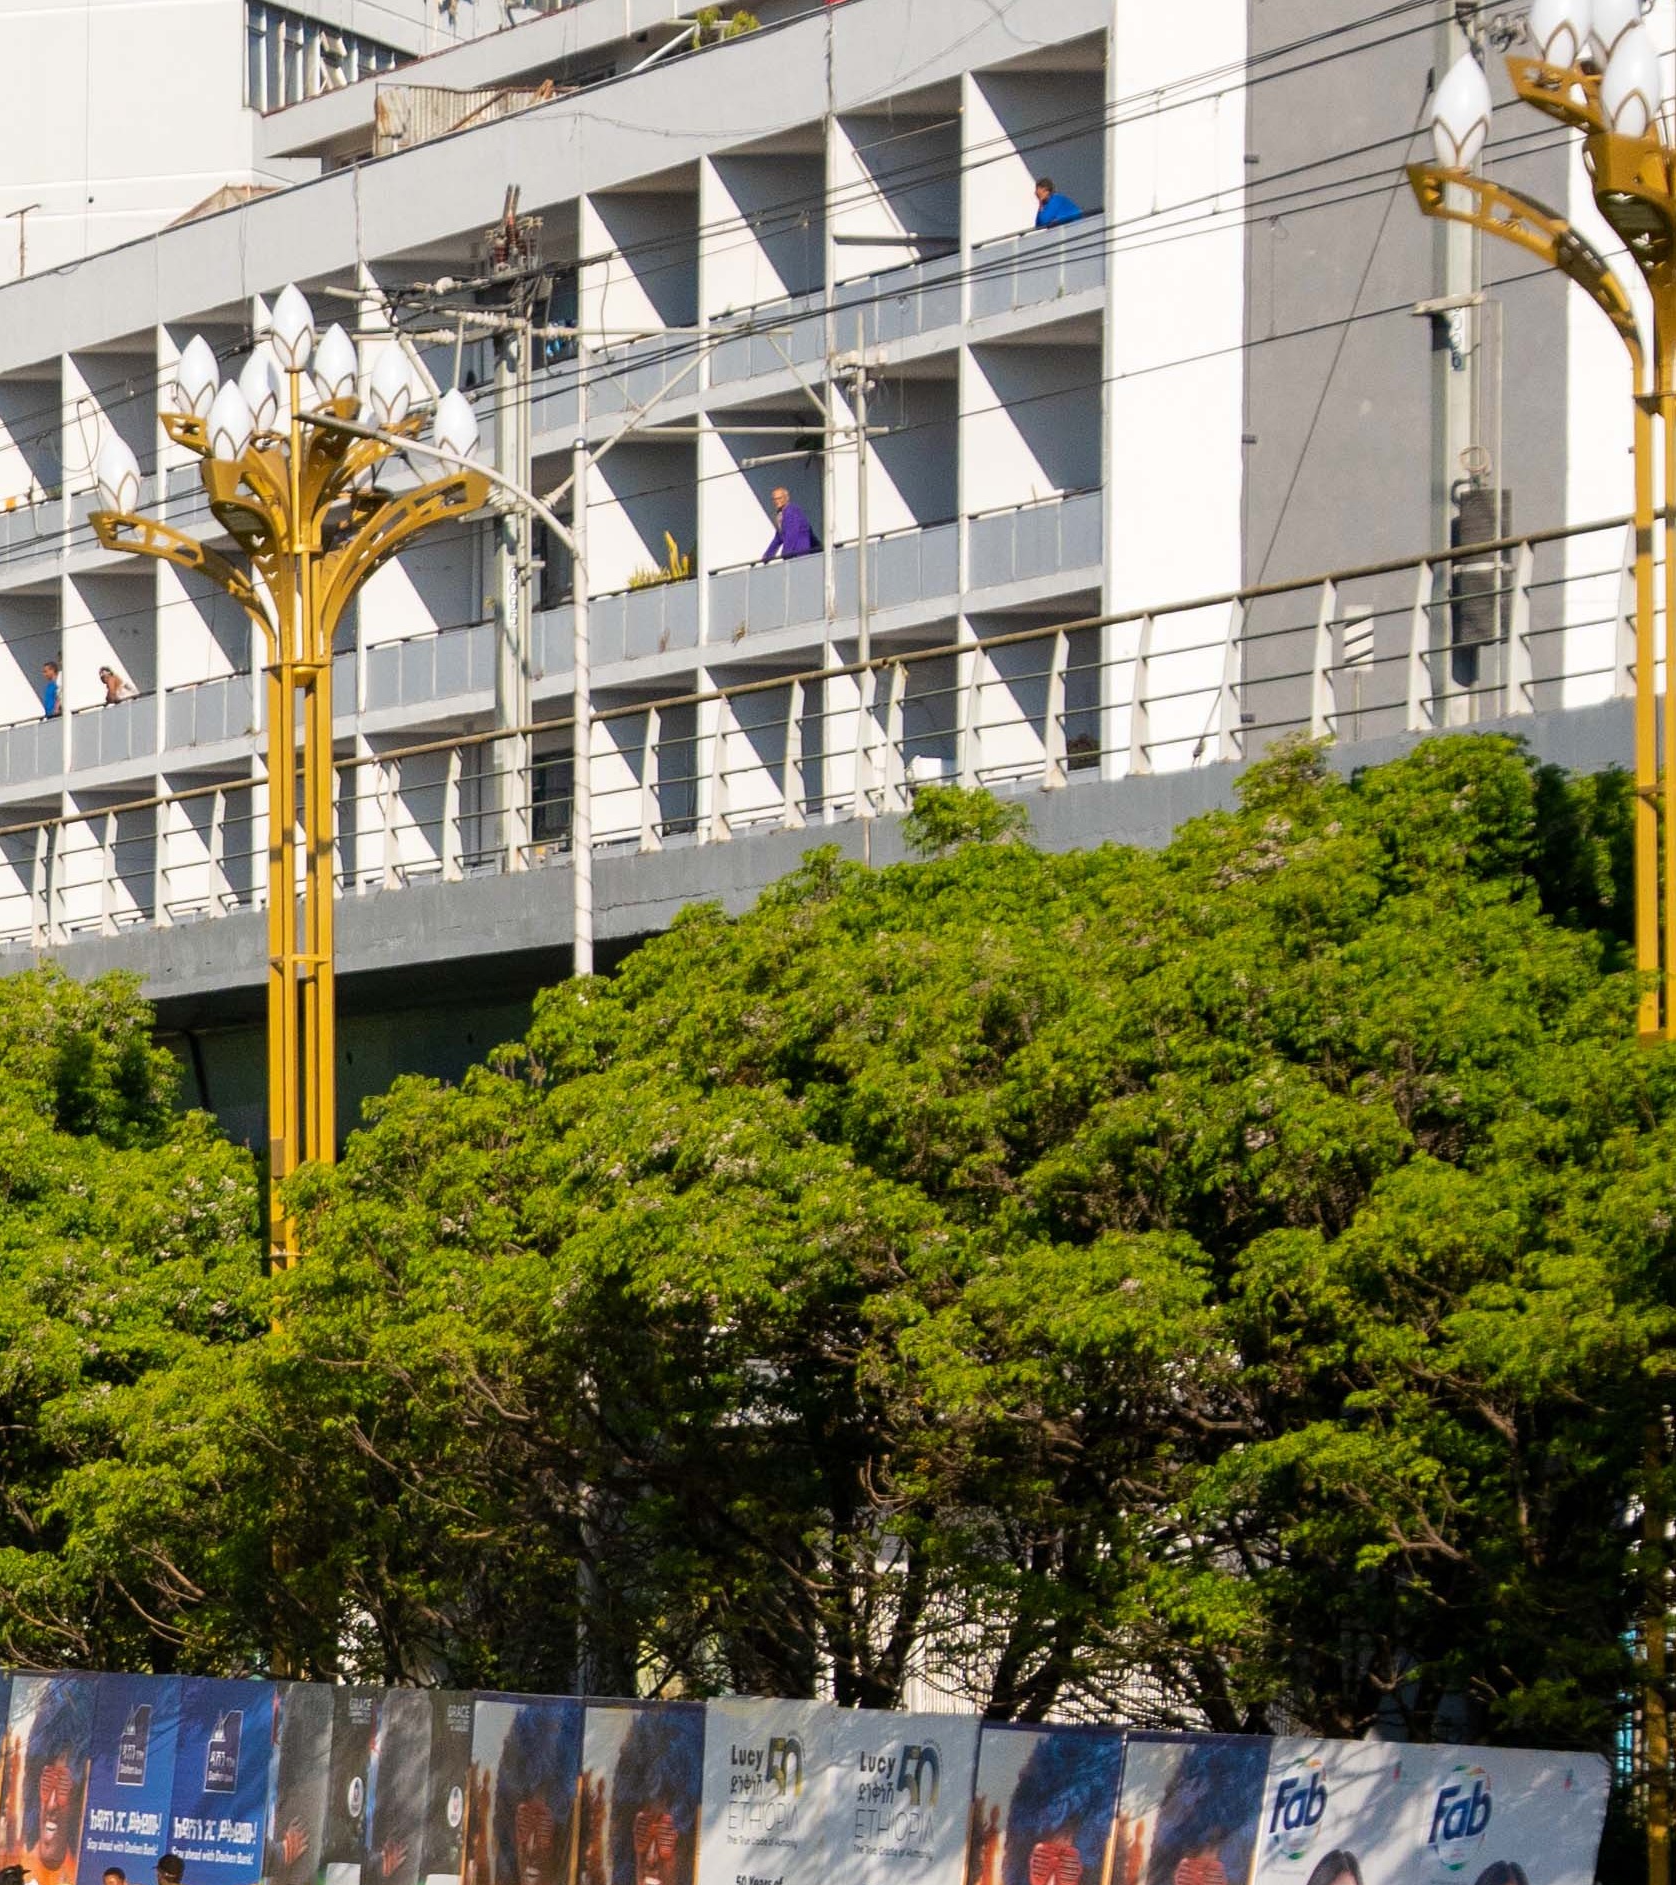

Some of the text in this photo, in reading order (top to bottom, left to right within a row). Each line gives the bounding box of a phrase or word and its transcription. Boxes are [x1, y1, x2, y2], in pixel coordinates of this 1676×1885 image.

[349, 1698, 373, 1711] GRACE
[448, 1704, 471, 1718] GRACE
[731, 1744, 763, 1771] Lucy
[860, 1751, 896, 1779] Lucy
[728, 1801, 799, 1831] ETHIOPIA
[1268, 1771, 1328, 1834] Fab
[1428, 1780, 1493, 1845] Fab
[855, 1809, 935, 1842] ETHIOPIA
